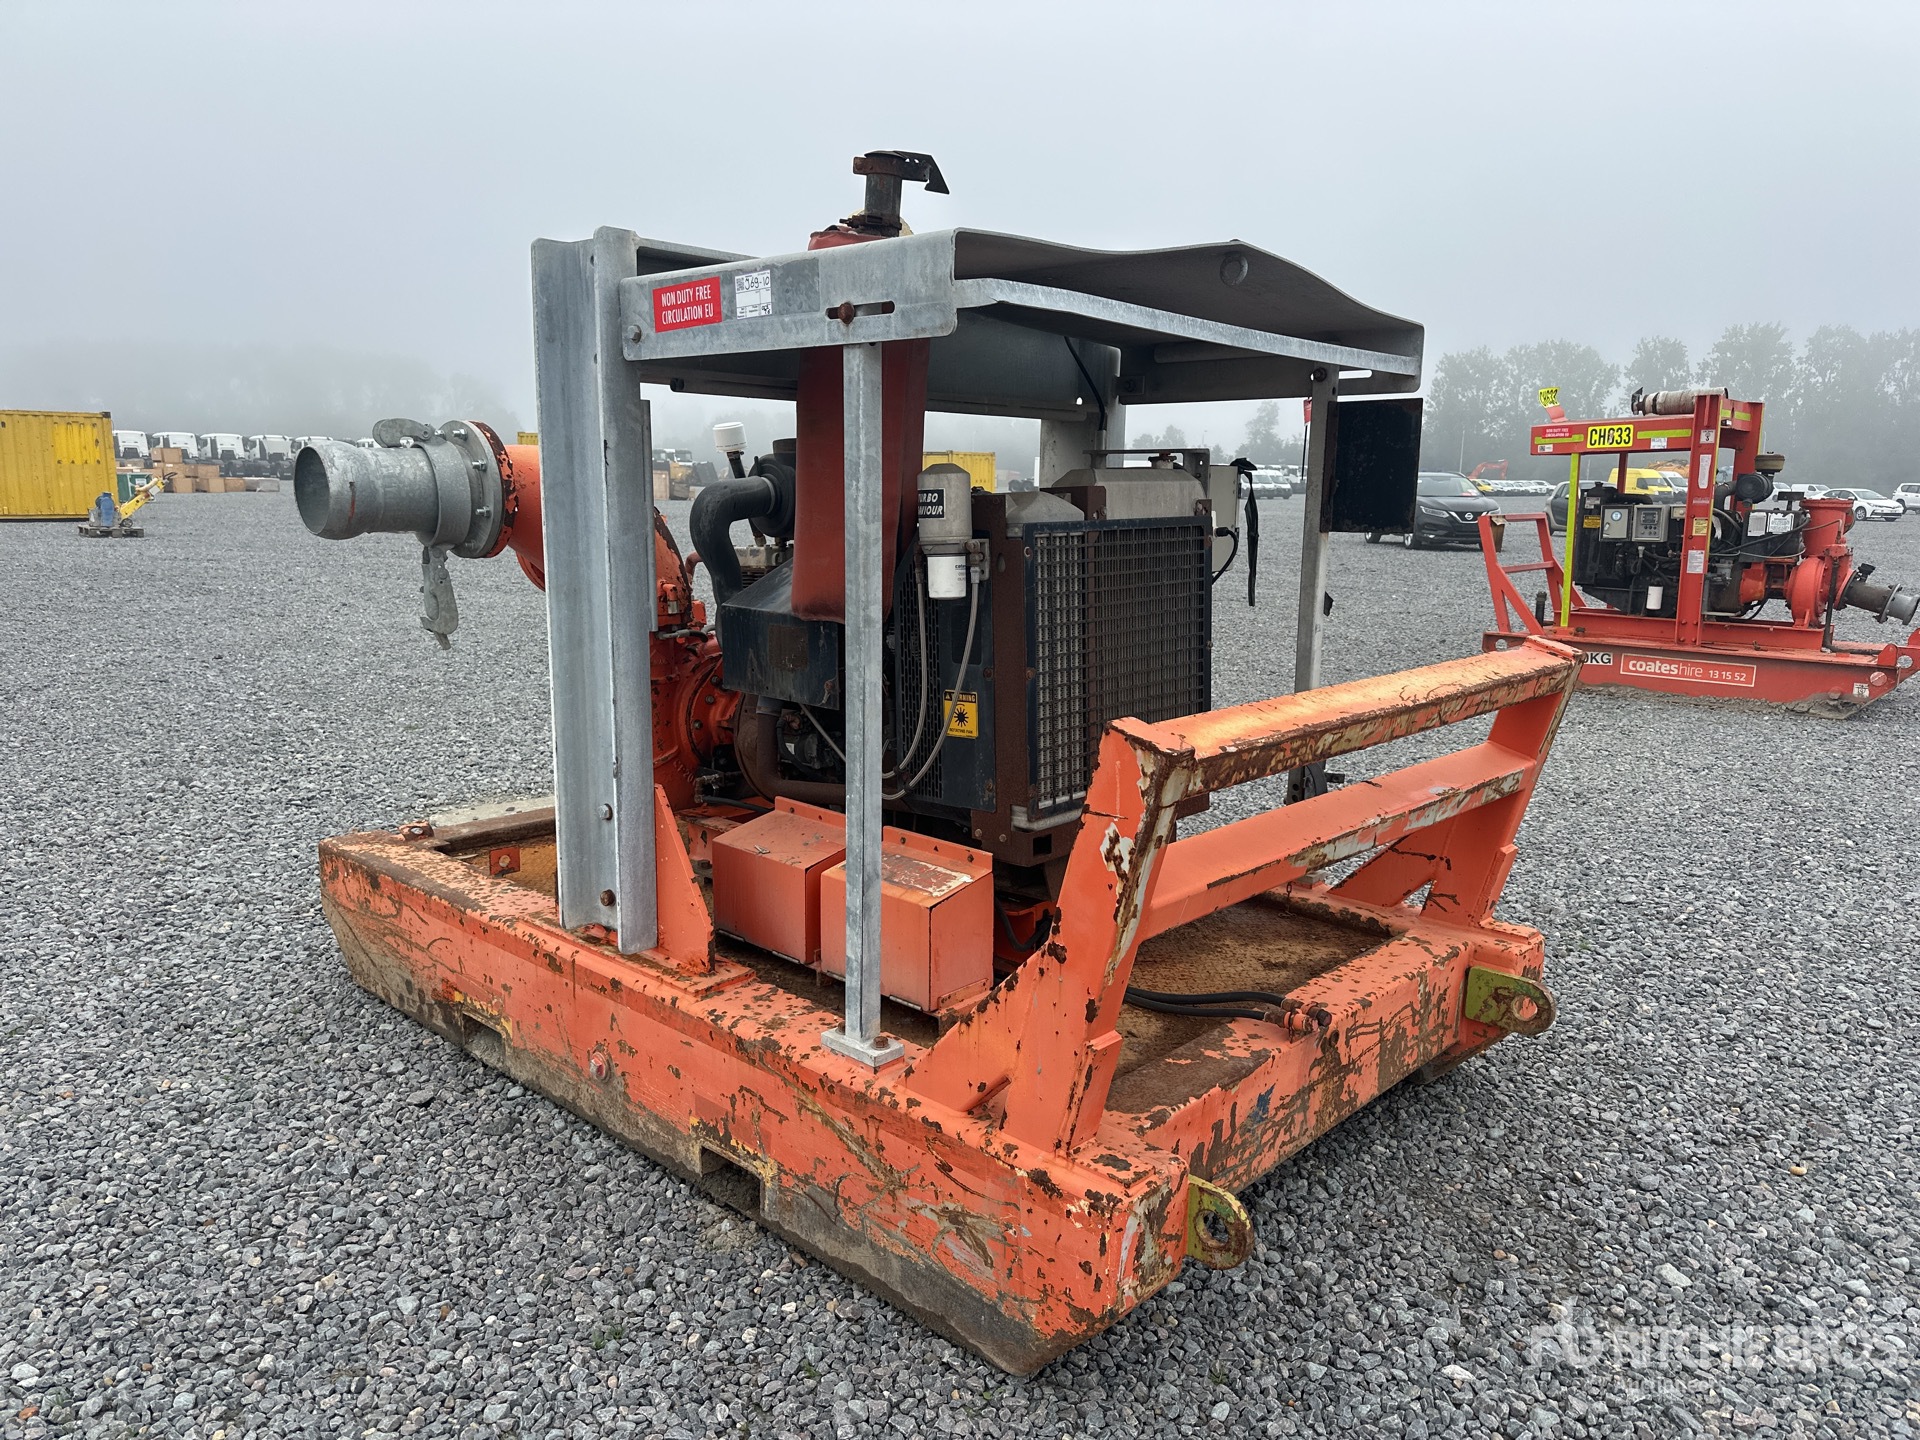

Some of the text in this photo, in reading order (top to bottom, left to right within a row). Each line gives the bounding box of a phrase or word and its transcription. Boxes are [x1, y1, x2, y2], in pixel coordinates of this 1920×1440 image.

[661, 285, 712, 307] NON DUTY FREE
[662, 303, 714, 325] CIRCULATION EU
[1589, 426, 1632, 446] CH633
[1708, 669, 1719, 679] 13
[1721, 671, 1732, 680] 15
[1734, 672, 1747, 682] 52
[952, 692, 976, 703] RNING
